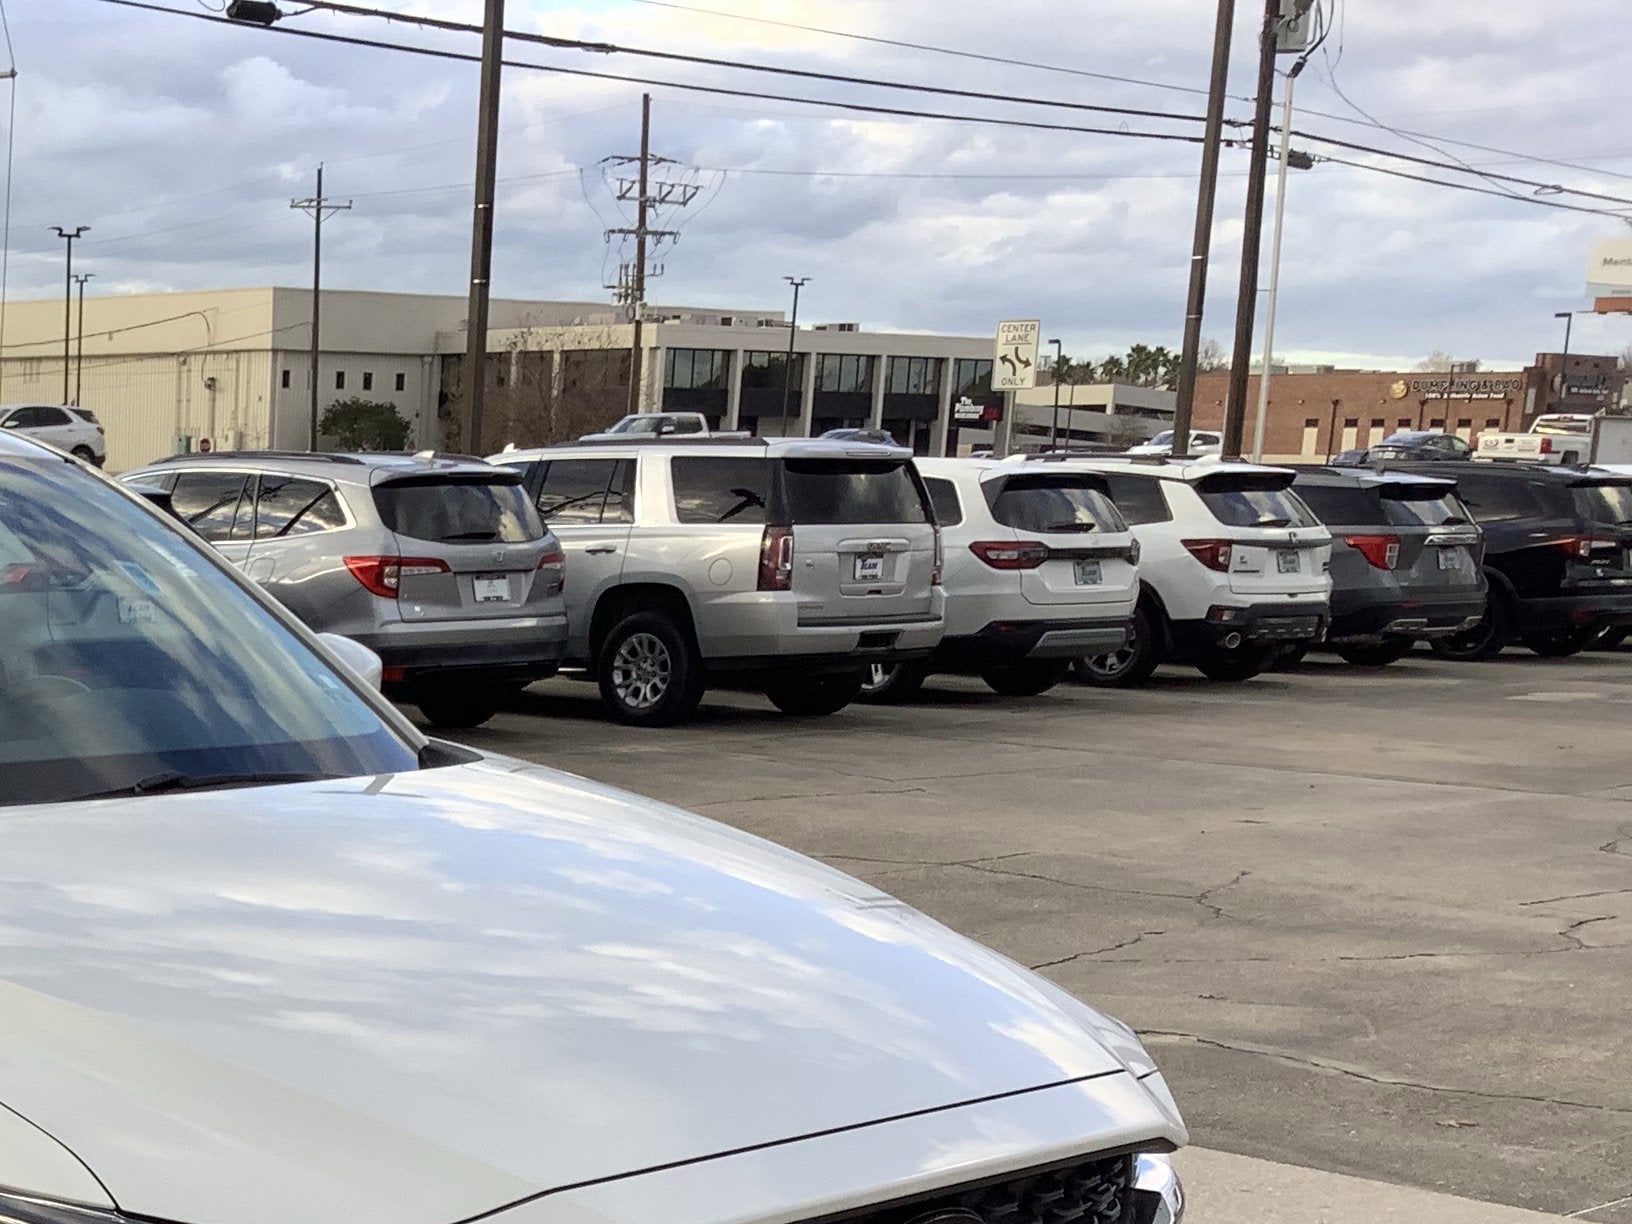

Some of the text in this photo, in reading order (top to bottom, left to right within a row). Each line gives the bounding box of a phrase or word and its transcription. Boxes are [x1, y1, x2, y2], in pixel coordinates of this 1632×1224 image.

[1001, 324, 1036, 333] CENTER
[1005, 334, 1029, 342] LANE
[1001, 377, 1025, 386] ONLY
[1412, 380, 1479, 391] DUMPING
